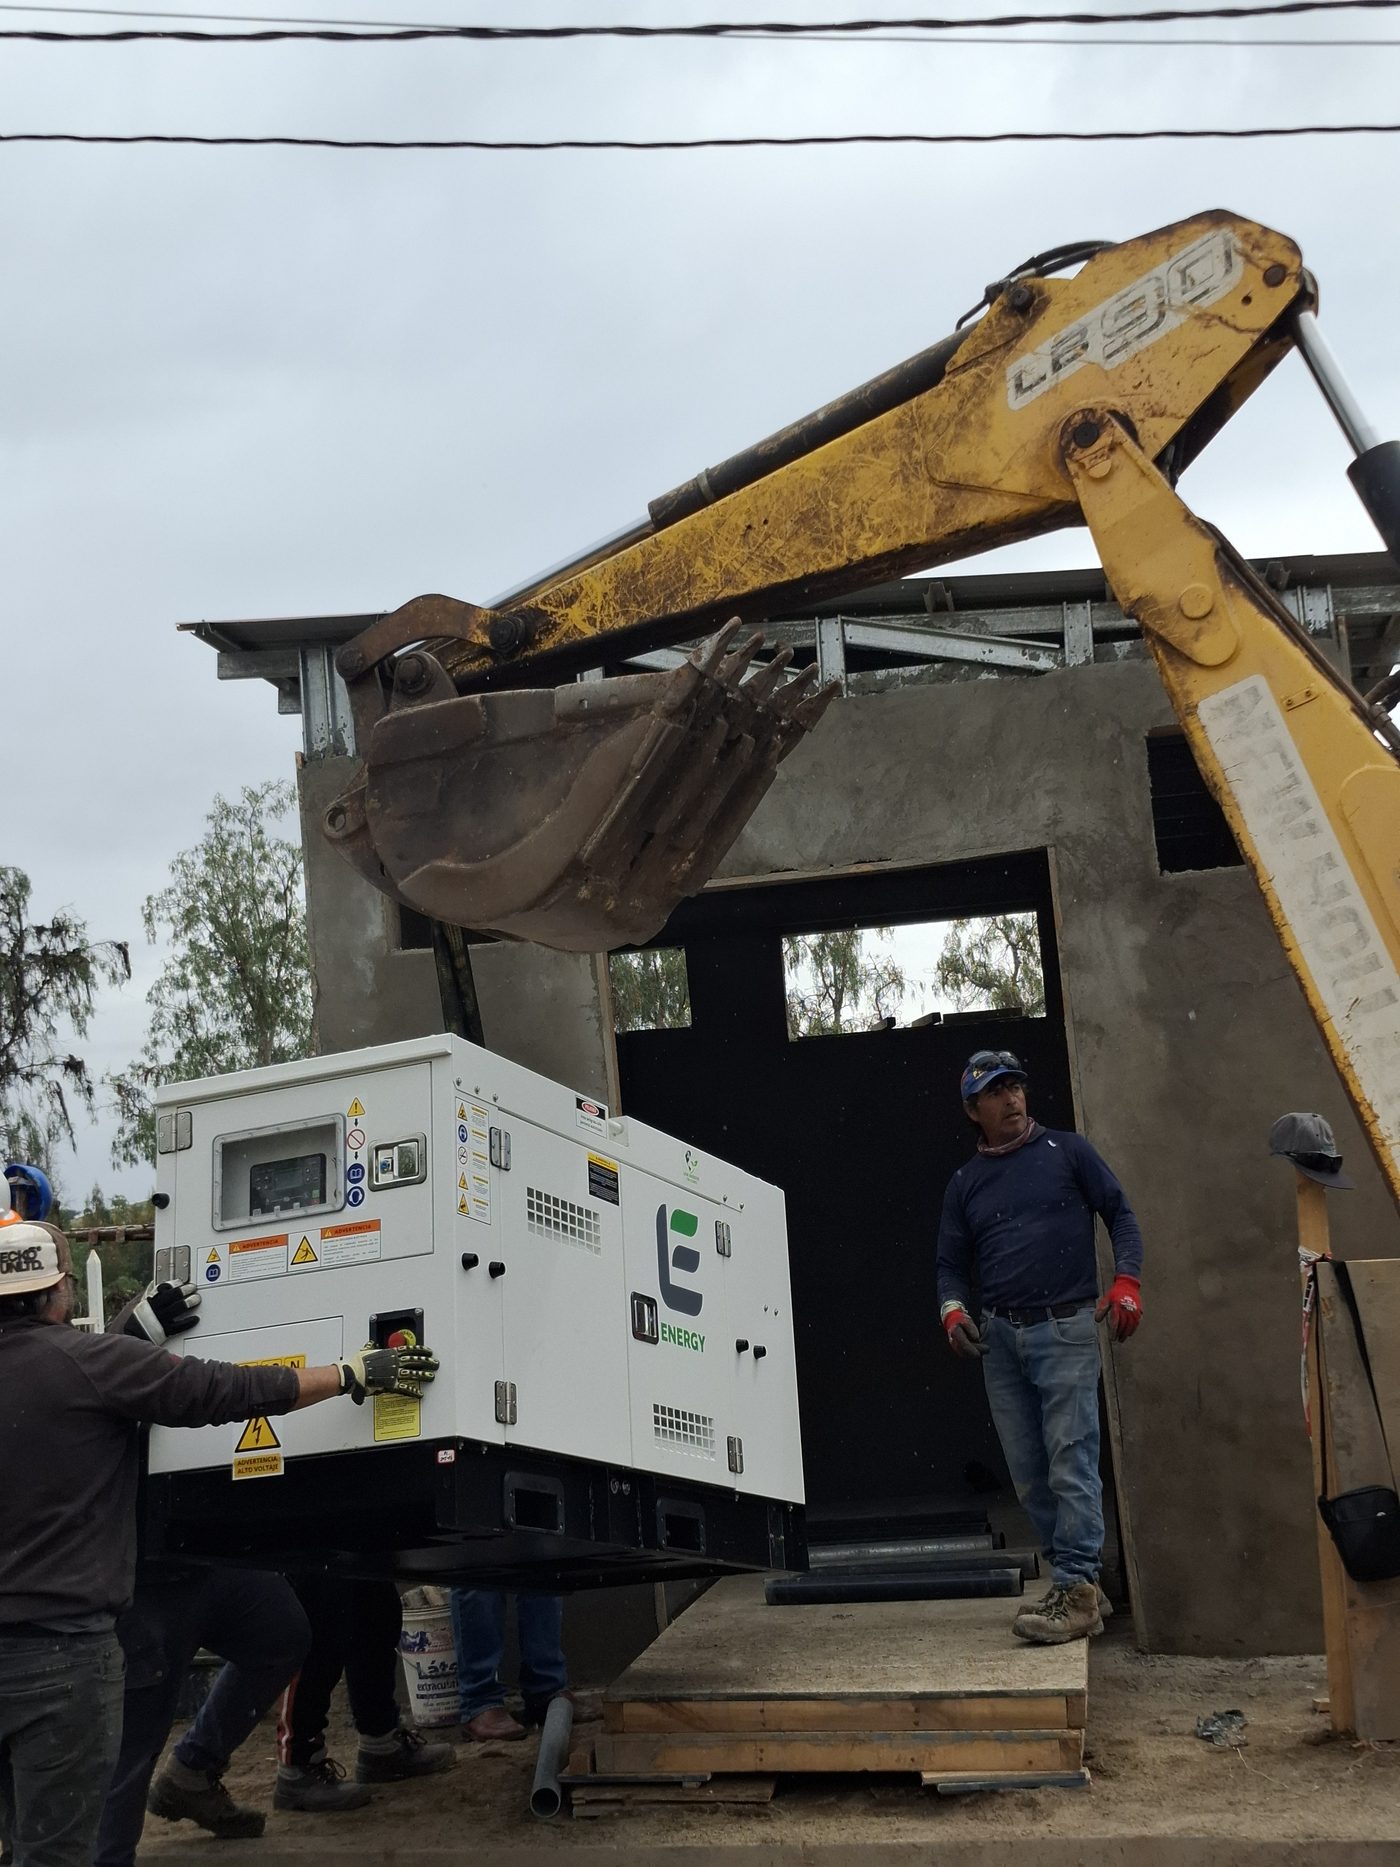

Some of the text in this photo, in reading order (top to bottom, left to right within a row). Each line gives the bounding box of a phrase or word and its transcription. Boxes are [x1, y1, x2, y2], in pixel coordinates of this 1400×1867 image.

[660, 1322, 706, 1353] ENERGY
[290, 1359, 300, 1369] N
[237, 1455, 278, 1466] ADVERTENCIA
[237, 1463, 279, 1475] ALTO VOLTAJE
